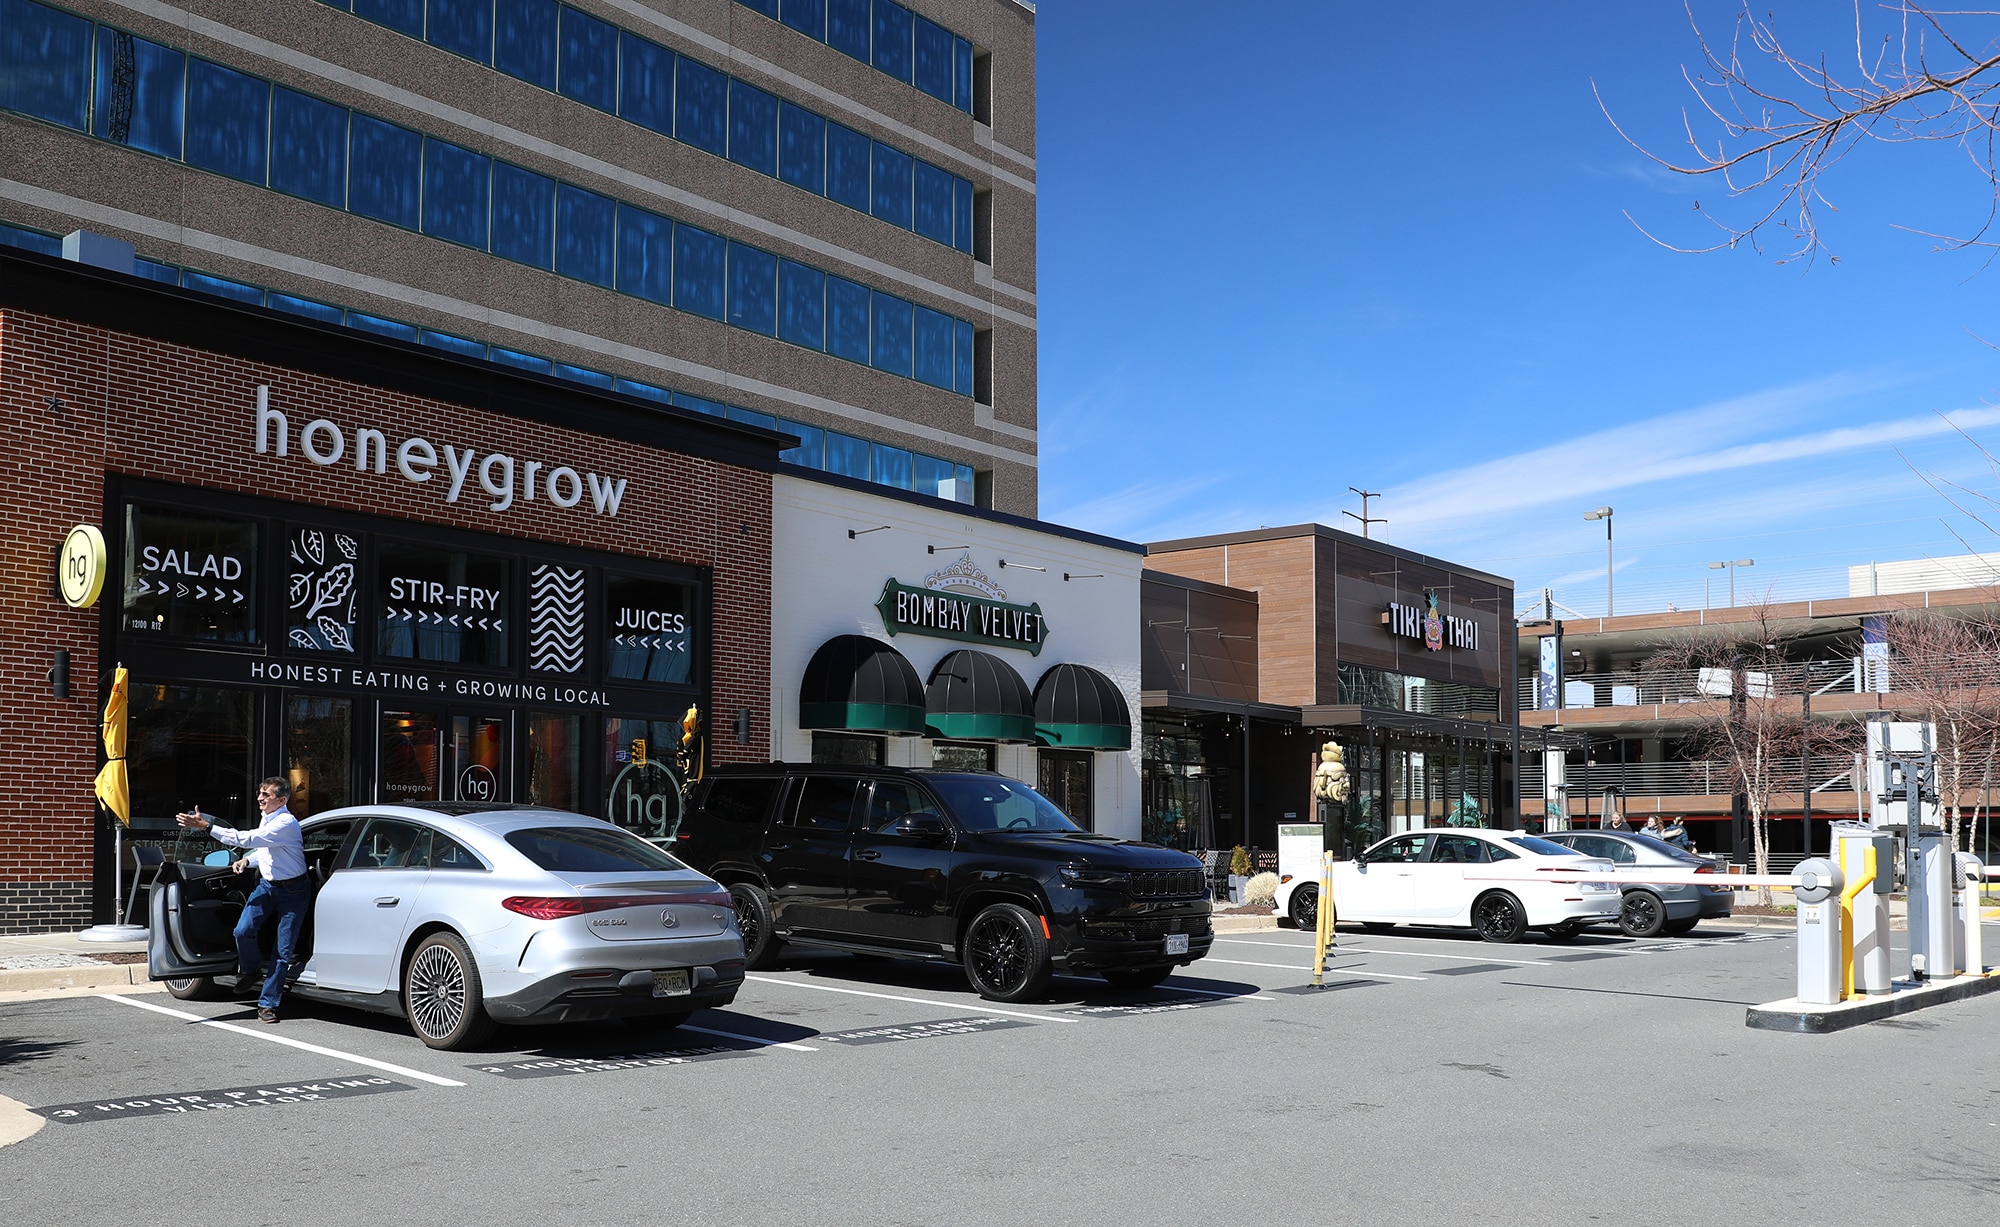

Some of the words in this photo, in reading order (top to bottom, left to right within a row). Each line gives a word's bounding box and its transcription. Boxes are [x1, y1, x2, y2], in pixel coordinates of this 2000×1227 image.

[255, 384, 628, 517] honeygrow
[67, 547, 87, 586] hg
[141, 545, 243, 581] SALAD
[389, 576, 501, 612] STIR-FRY
[614, 606, 686, 635] JUICES
[896, 590, 971, 632] BOMBAY
[979, 605, 1043, 644] VELVET
[1387, 602, 1422, 639] TIKI
[1446, 616, 1479, 651] THAI
[251, 661, 343, 684] HONEST
[352, 671, 429, 692] EATING
[437, 681, 447, 693] +
[455, 680, 547, 702] GROWING
[554, 690, 611, 706] LOCAL
[386, 781, 433, 794] honeygrow
[468, 773, 489, 800] hg
[626, 778, 667, 838] hg
[512, 1057, 597, 1071] HOUR
[562, 1056, 692, 1074] VISITOR
[52, 1109, 80, 1118] 3
[94, 1094, 208, 1112] HOUR
[224, 1077, 392, 1099] PARKING
[162, 1092, 327, 1113] VISITOR
